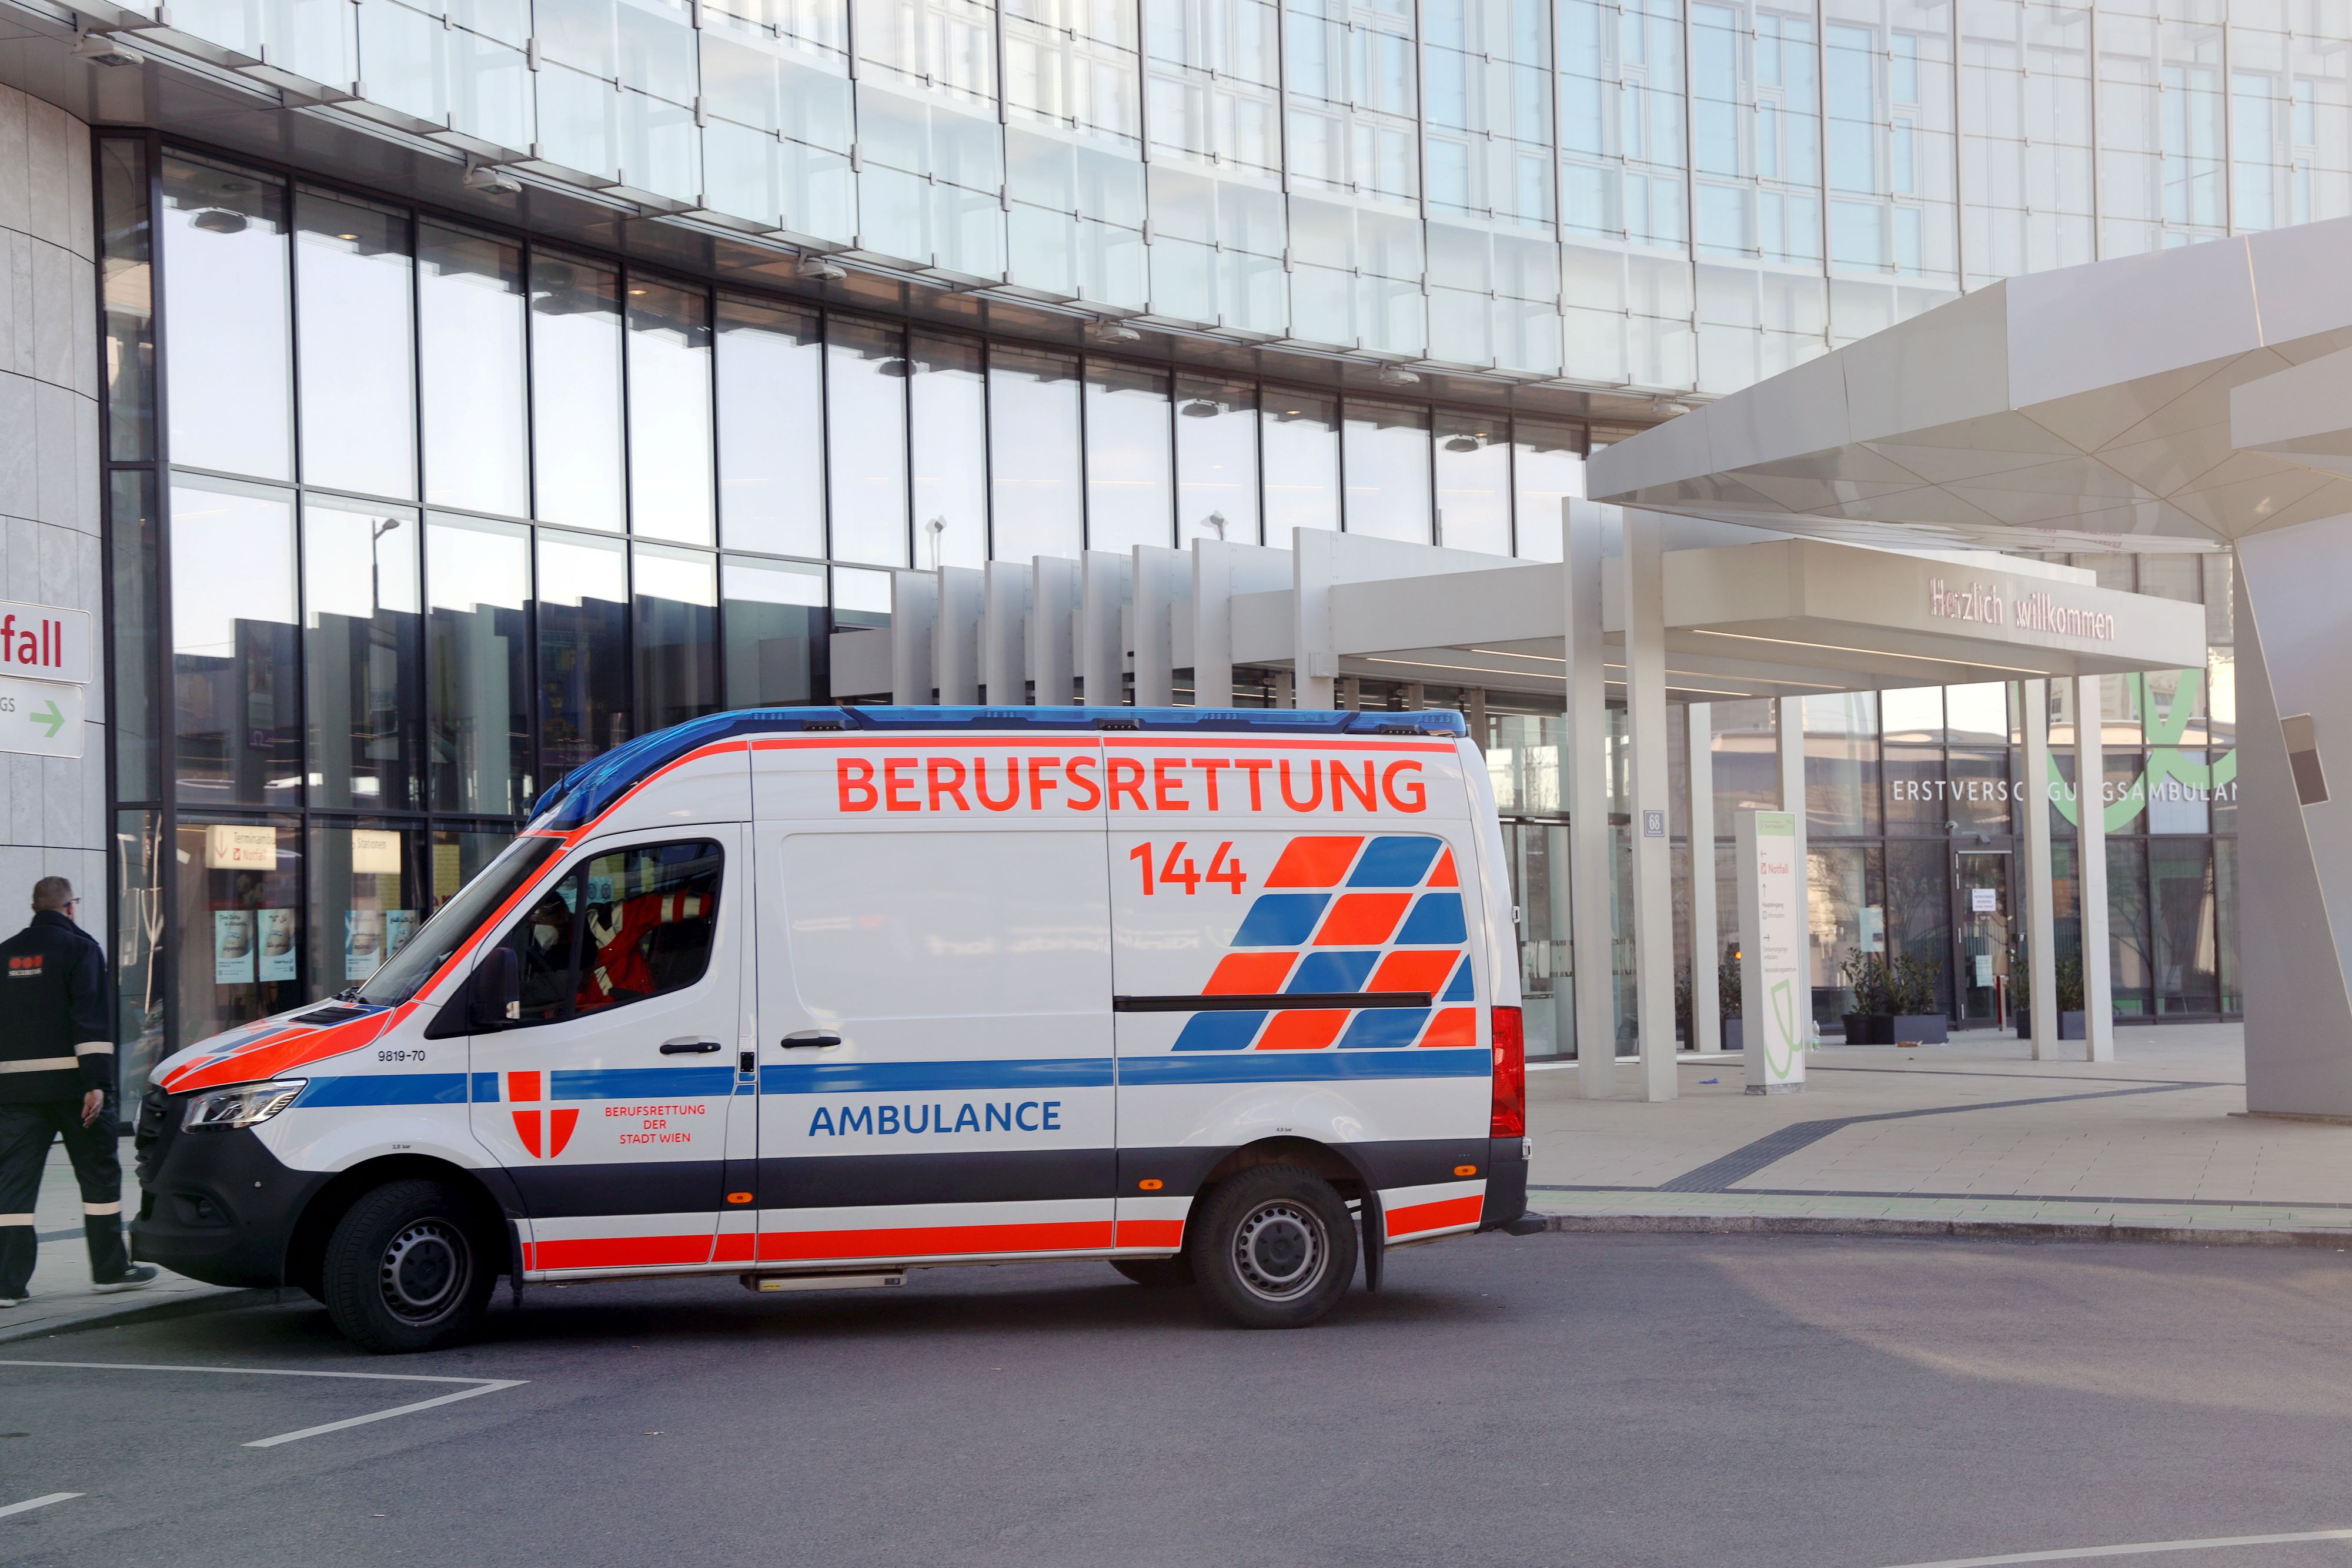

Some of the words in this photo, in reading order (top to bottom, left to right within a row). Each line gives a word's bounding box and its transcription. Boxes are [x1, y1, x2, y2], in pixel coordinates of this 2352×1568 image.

[1930, 578, 2003, 624] Herzlich
[2013, 592, 2114, 640] willkommen
[1, 614, 61, 667] fall
[836, 755, 1428, 813] BERUFSRETTUNG
[1649, 814, 1660, 830] 68
[357, 837, 386, 850] Stationen
[1129, 841, 1247, 896] 144
[1768, 863, 1789, 874] Notfall
[378, 1050, 425, 1061] 9819-70
[605, 1105, 706, 1117] BERUFSRETTUNG
[643, 1119, 667, 1129] DER
[808, 1101, 1061, 1137] AMBULANCE
[620, 1134, 656, 1144] STADT
[660, 1133, 691, 1143] WIEN
